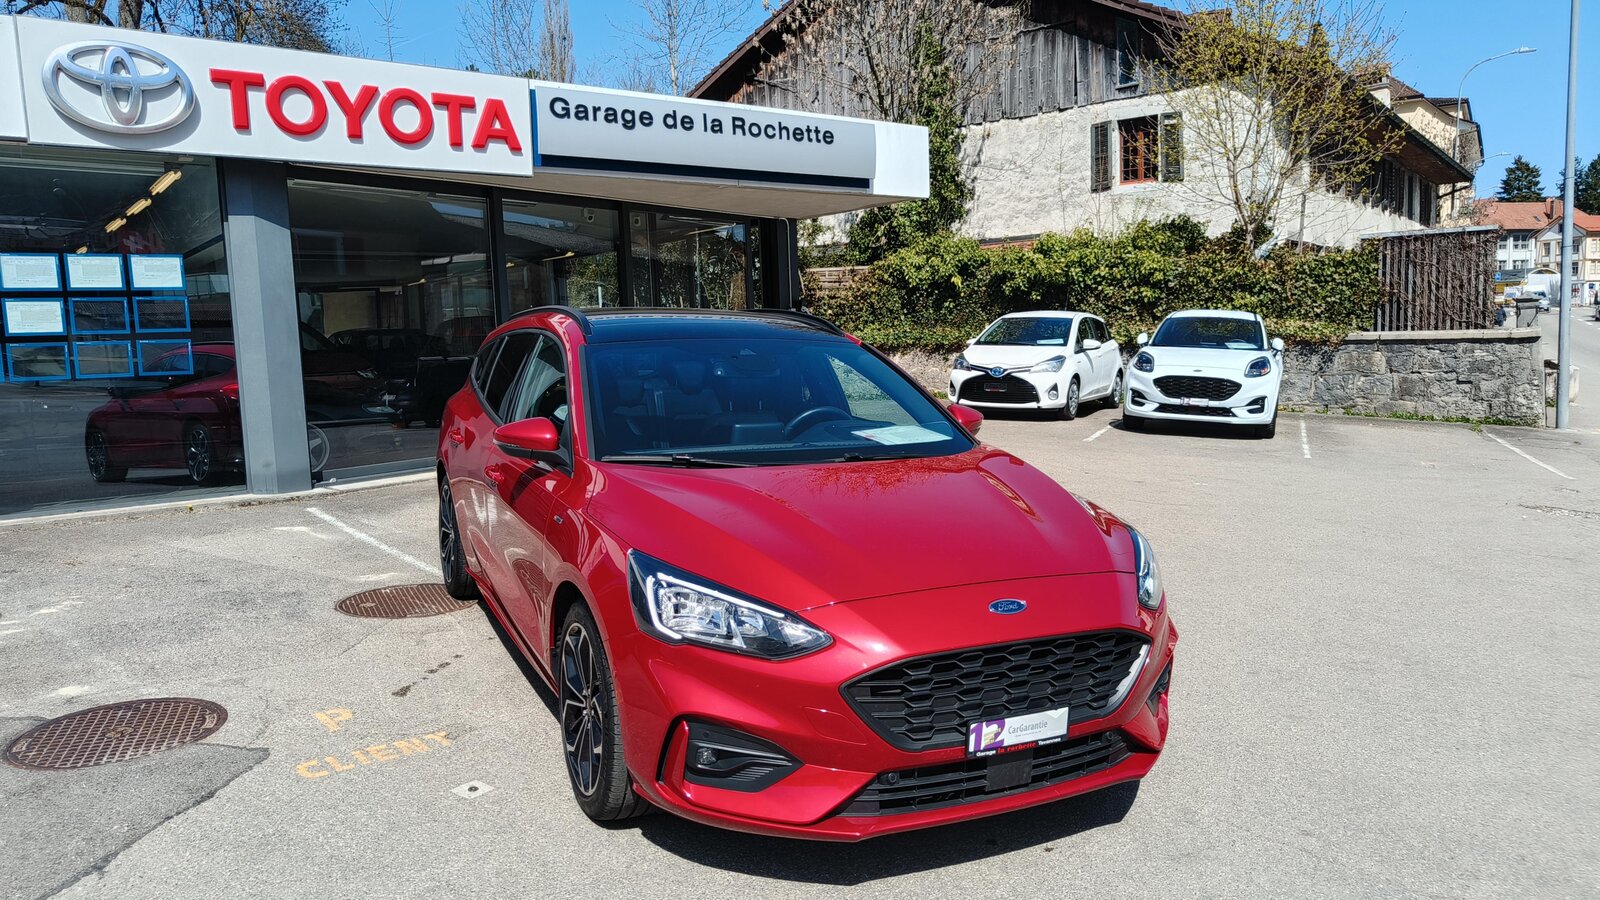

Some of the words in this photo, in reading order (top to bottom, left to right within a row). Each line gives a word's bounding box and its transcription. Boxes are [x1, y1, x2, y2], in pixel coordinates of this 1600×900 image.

[209, 68, 522, 152] TOYOTA
[549, 97, 654, 130] Garage
[662, 110, 695, 131] de
[702, 113, 724, 135] la
[731, 116, 835, 145] Rochette
[314, 707, 353, 732] P
[1008, 720, 1048, 734] CarGarantie
[296, 730, 452, 778] CLIENT
